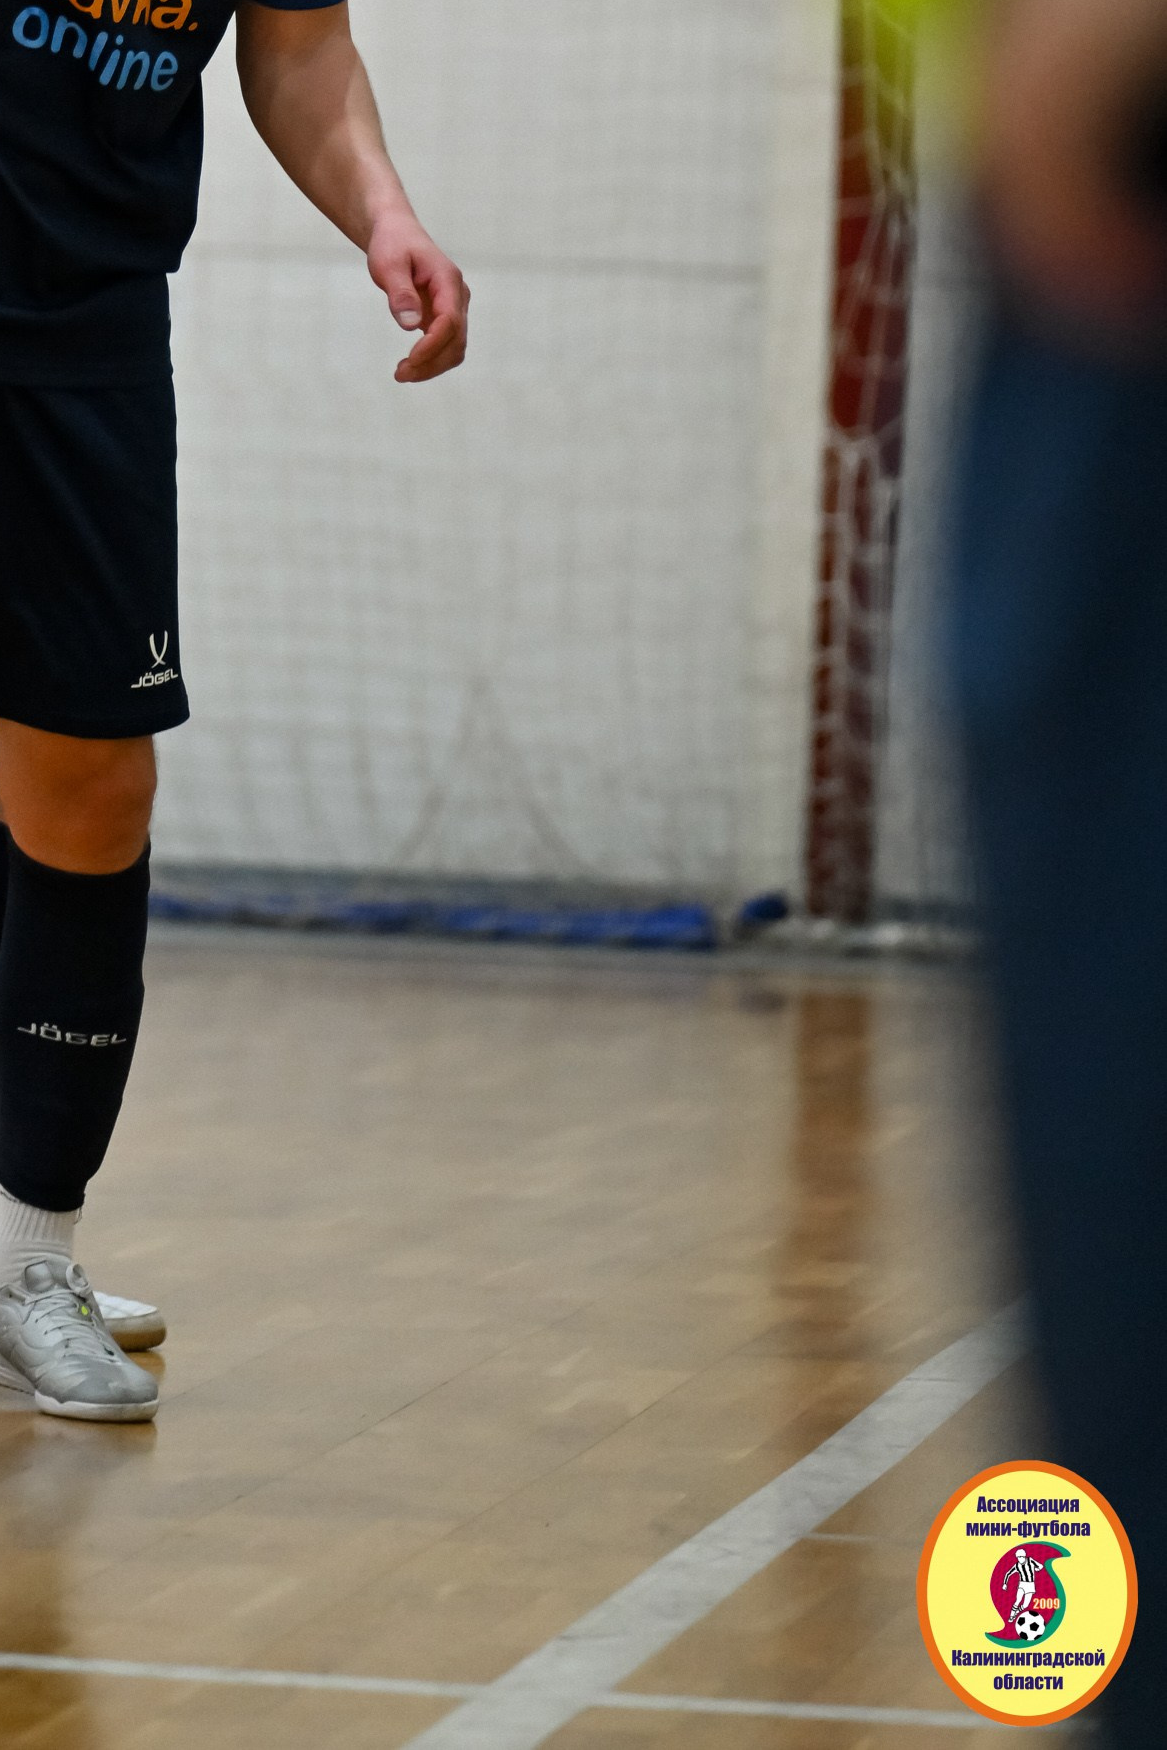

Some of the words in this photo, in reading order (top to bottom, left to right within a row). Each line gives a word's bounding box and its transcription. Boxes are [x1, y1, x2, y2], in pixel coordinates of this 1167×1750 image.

[12, 6, 179, 91] online
[131, 668, 179, 689] JÖGEL
[17, 1022, 128, 1048] JÖGEL
